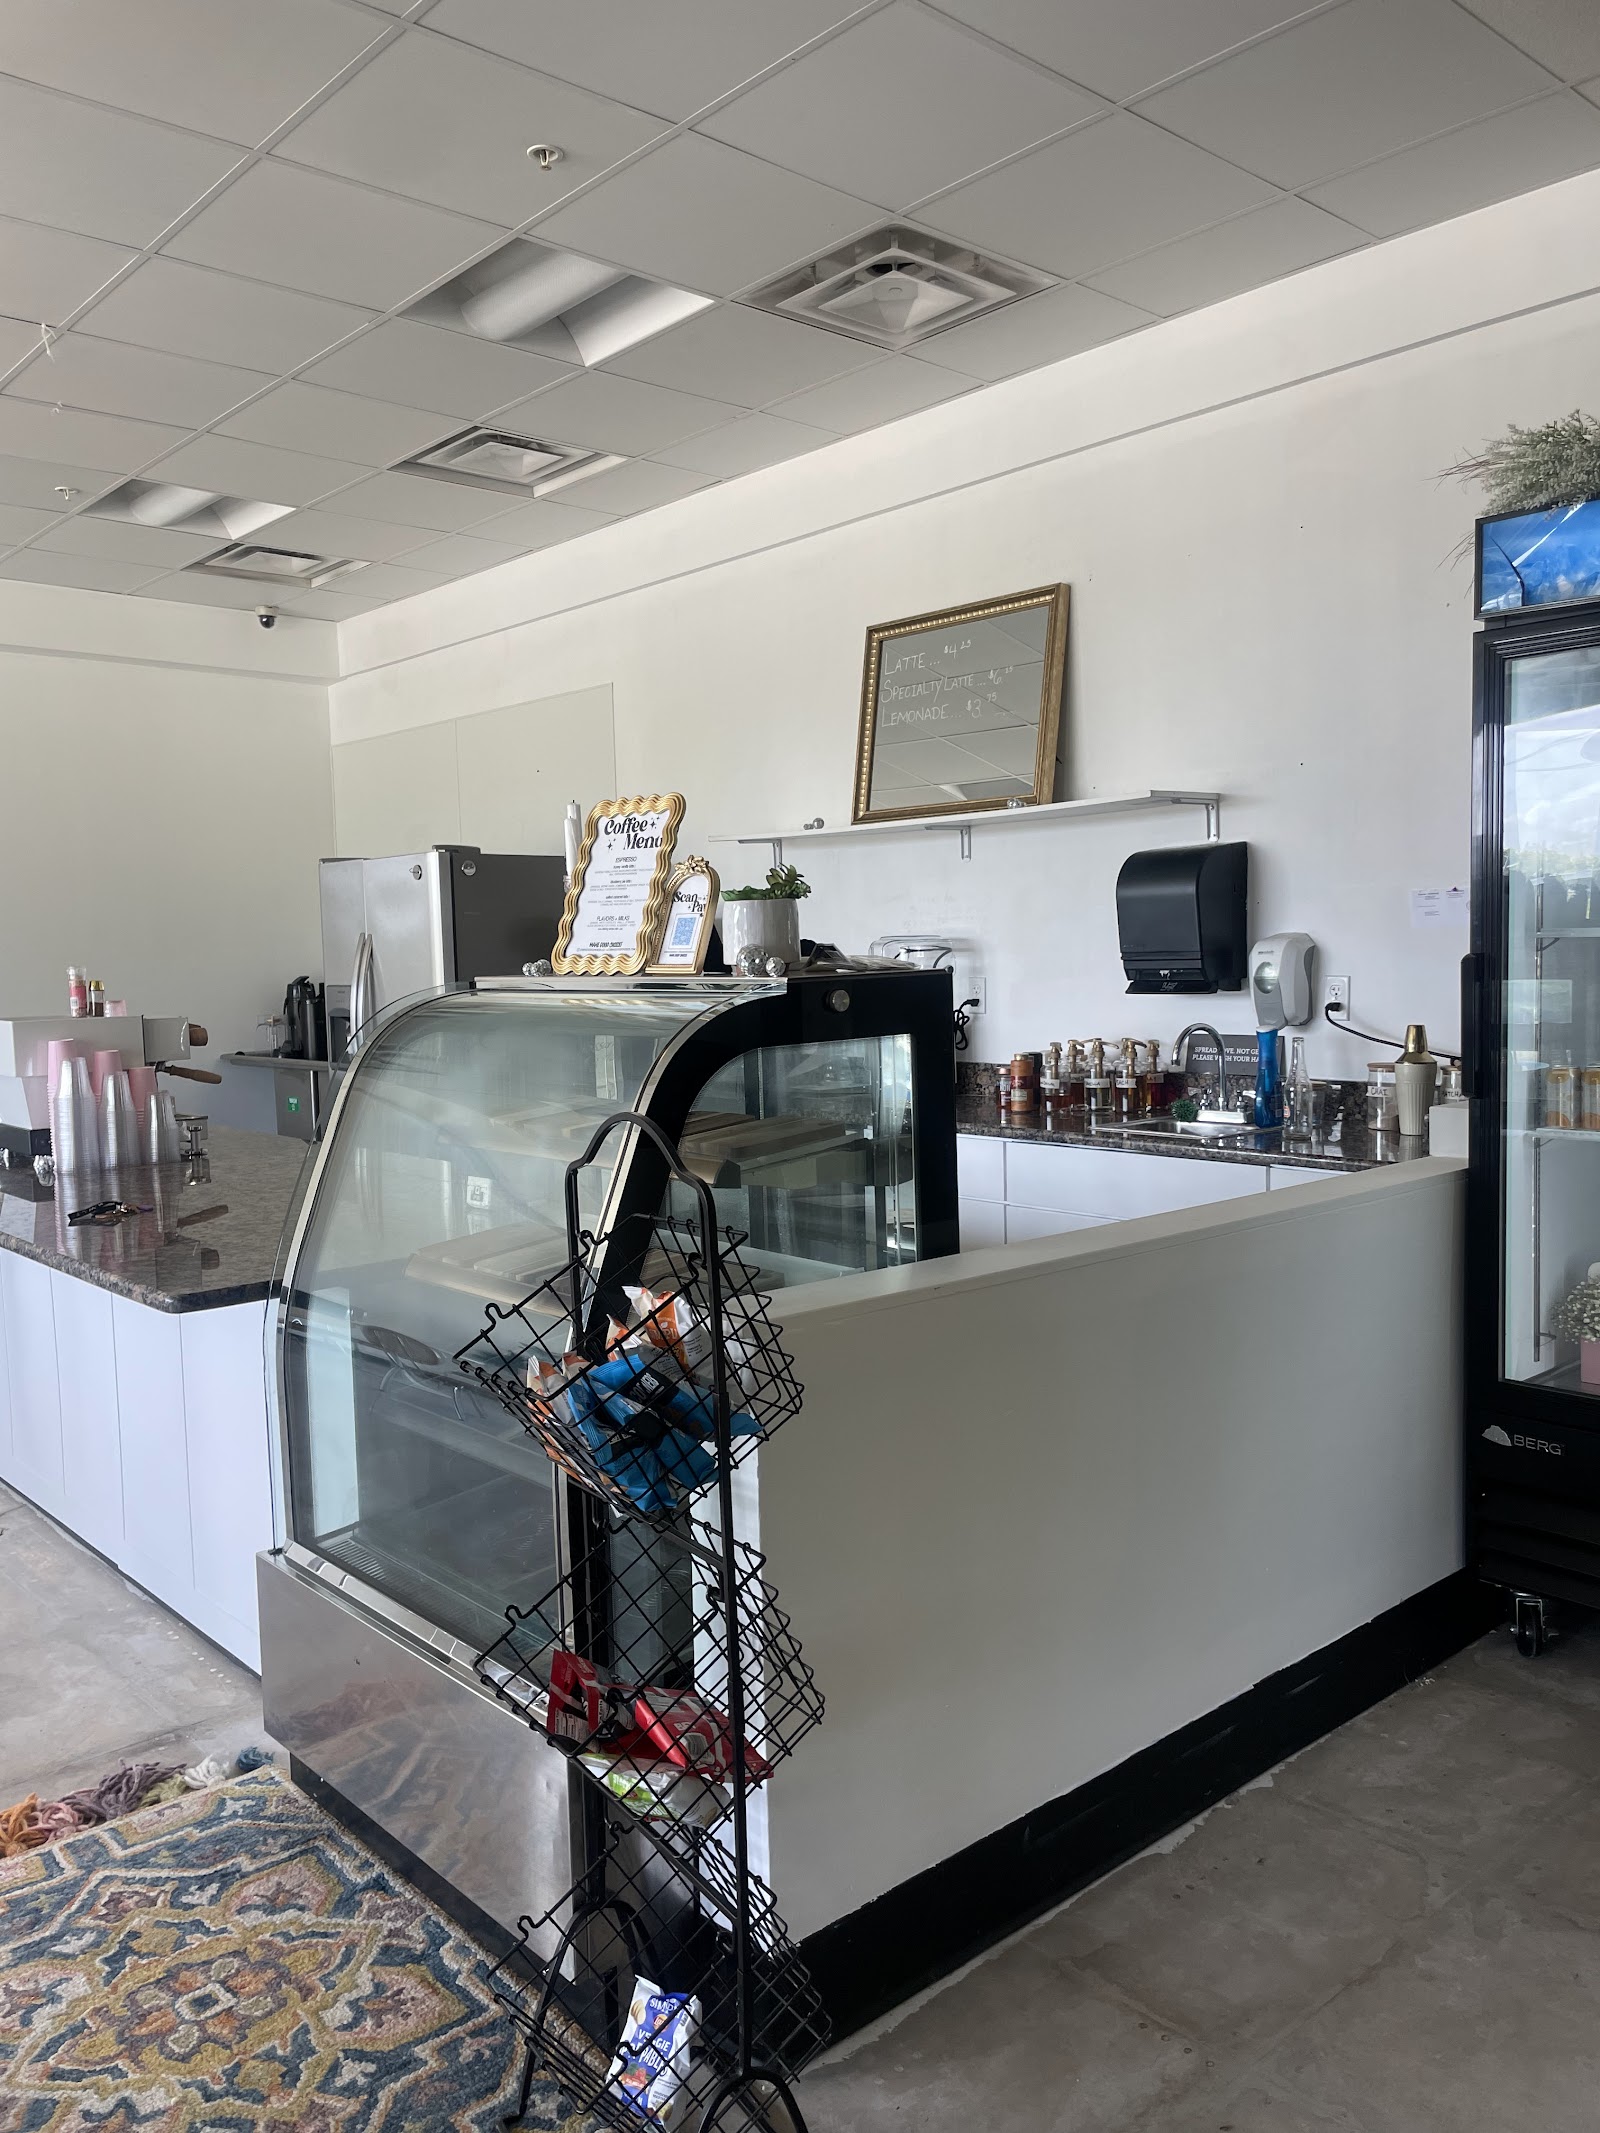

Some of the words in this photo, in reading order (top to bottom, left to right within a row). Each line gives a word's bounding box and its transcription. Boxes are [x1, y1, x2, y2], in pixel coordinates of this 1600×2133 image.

[604, 817, 649, 836] Coffee
[673, 891, 698, 902] Scan
[1513, 1434, 1562, 1456] BERG
